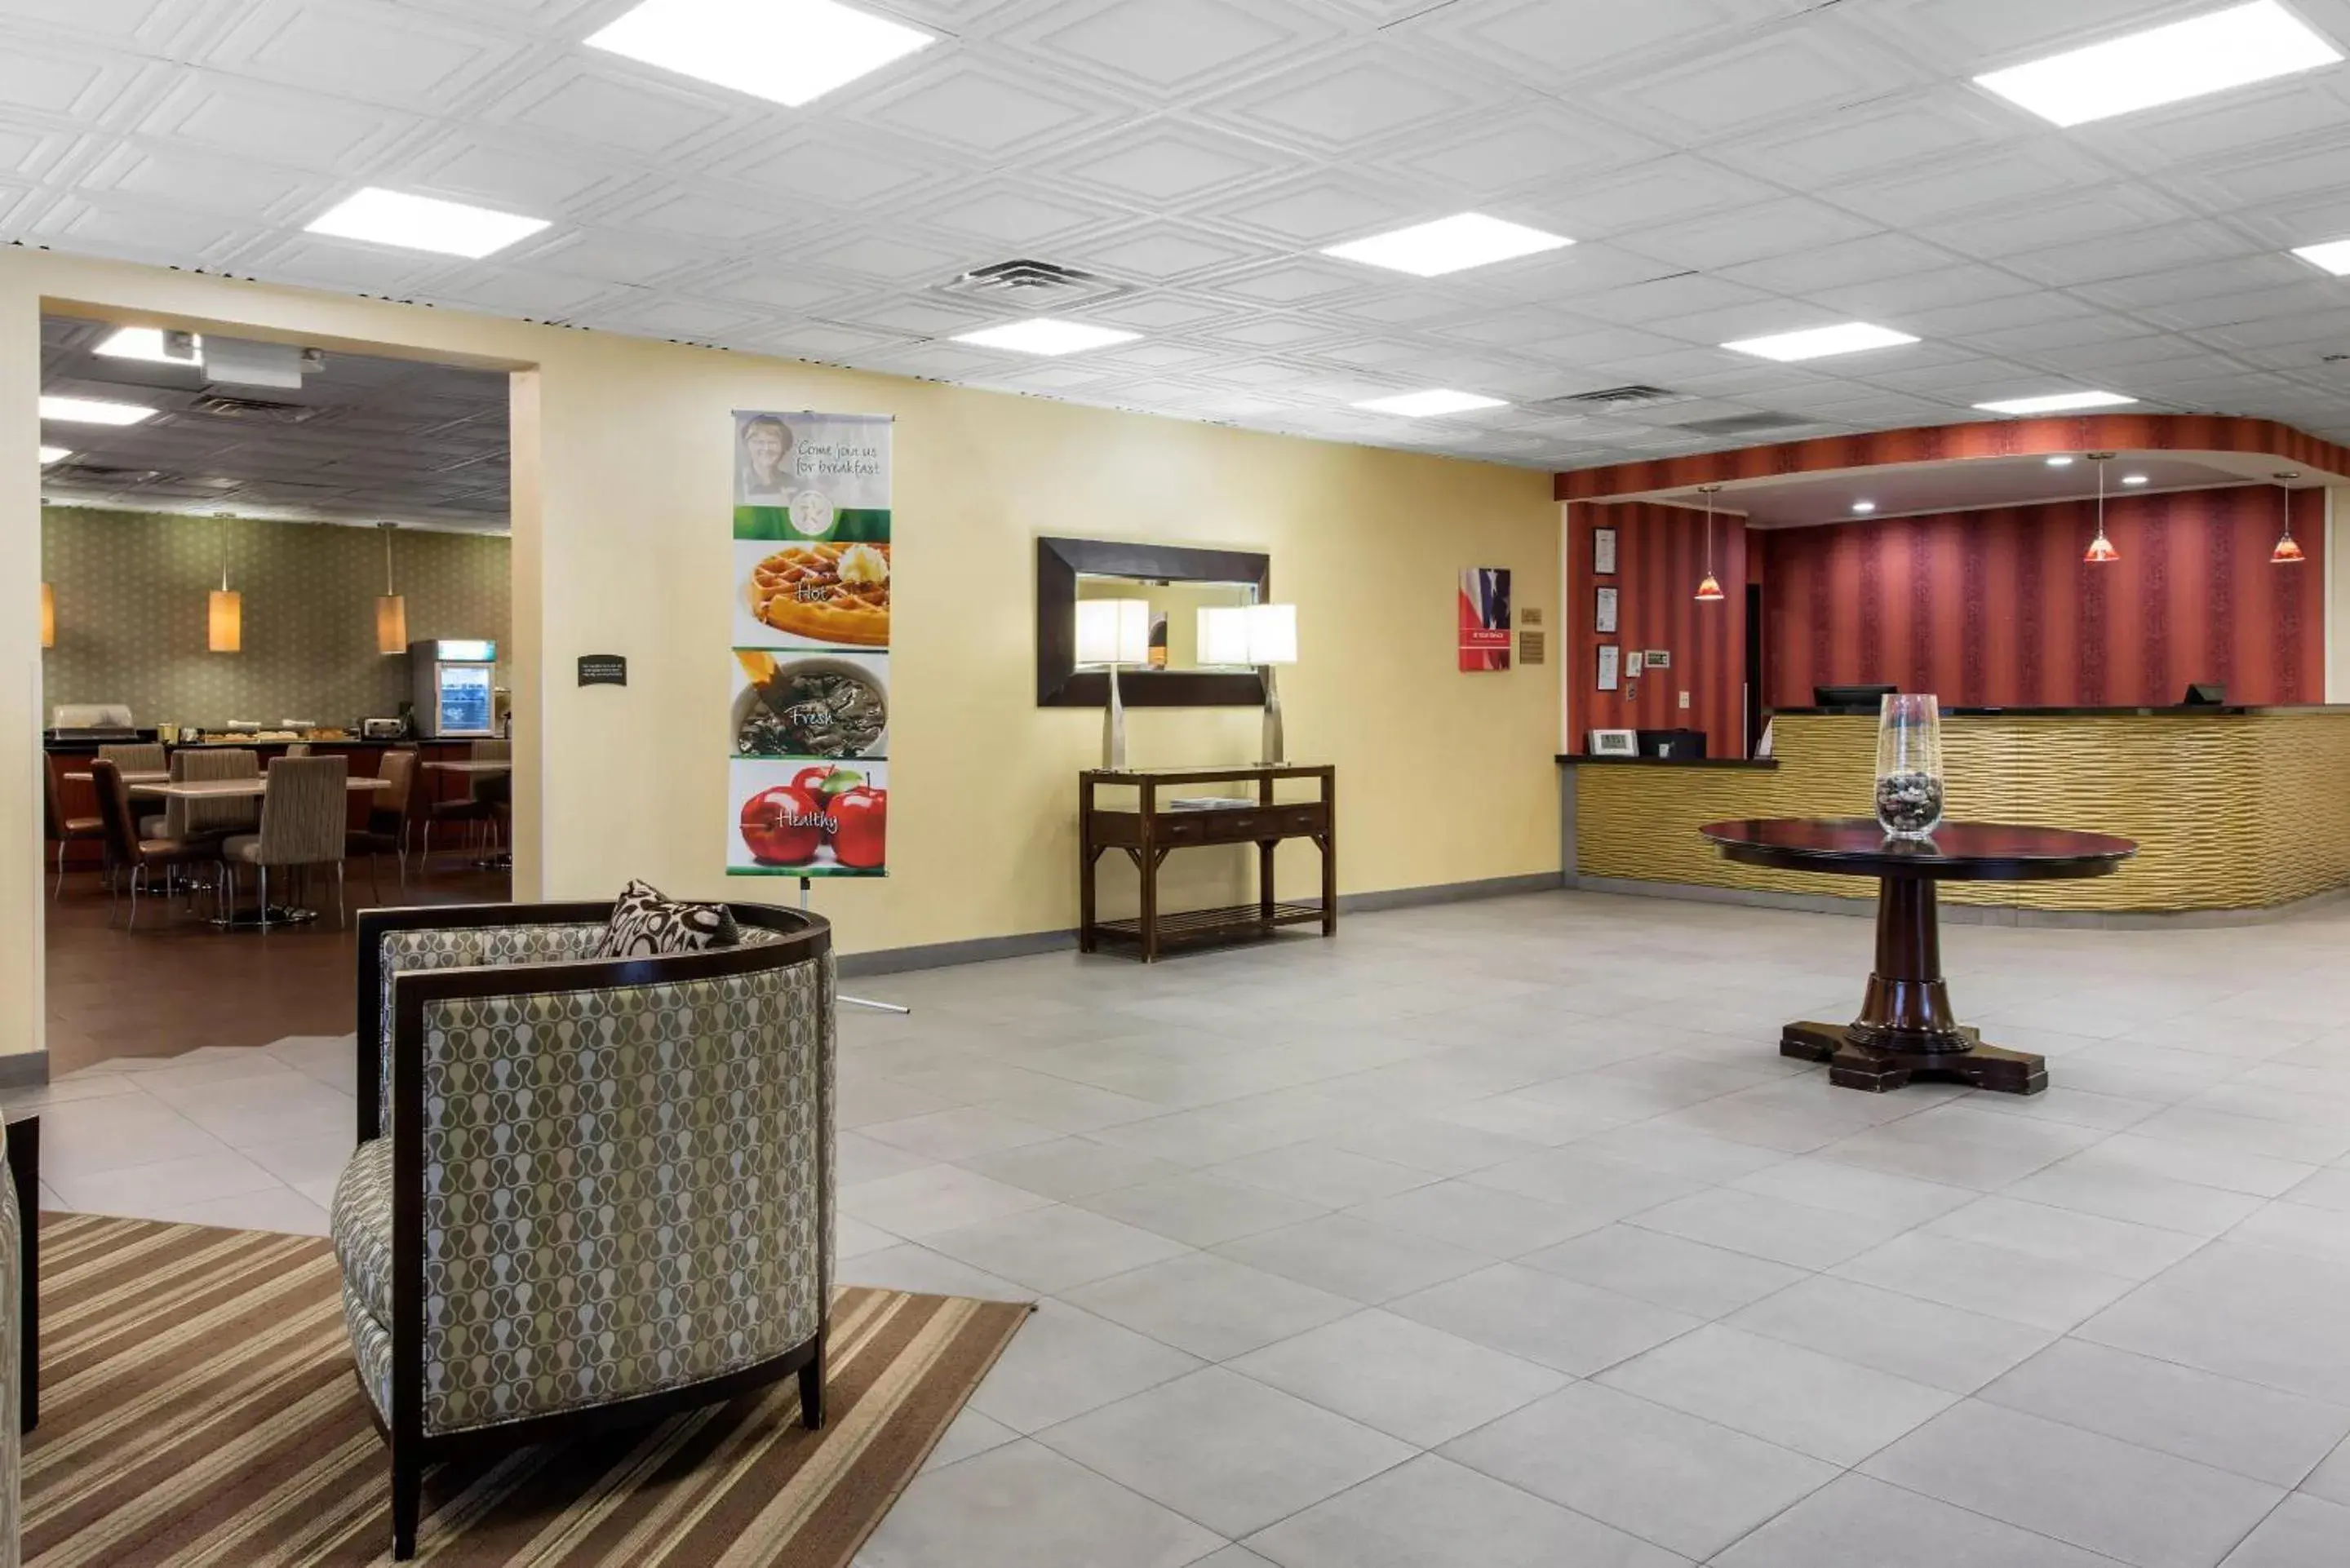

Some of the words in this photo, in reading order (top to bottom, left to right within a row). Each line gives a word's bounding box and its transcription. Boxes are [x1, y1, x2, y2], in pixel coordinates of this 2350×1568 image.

[798, 440, 831, 455] Come
[836, 442, 859, 459] join
[862, 448, 877, 458] us
[796, 457, 815, 475] for
[818, 459, 880, 478] breakfast
[796, 578, 827, 602] Hot
[784, 704, 835, 726] Fresh
[777, 808, 838, 835] Healthy
